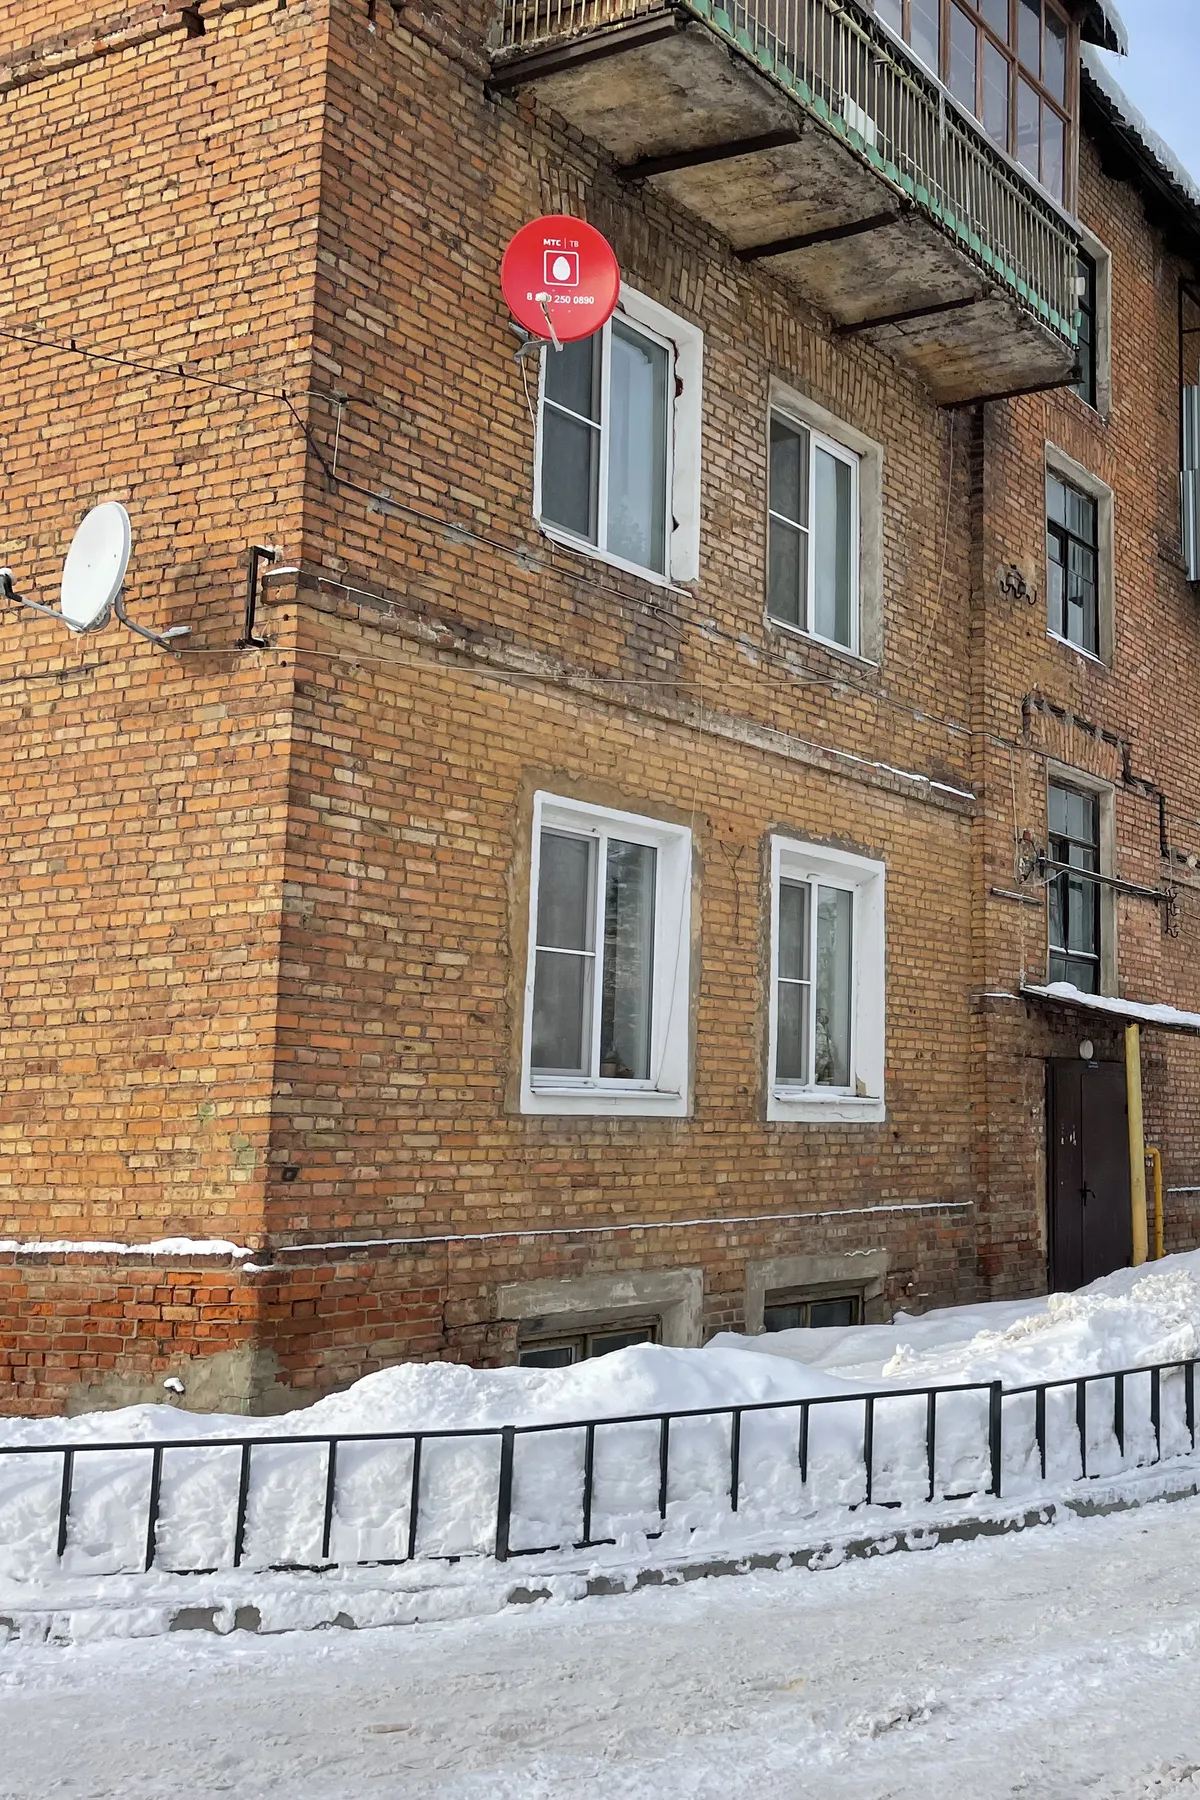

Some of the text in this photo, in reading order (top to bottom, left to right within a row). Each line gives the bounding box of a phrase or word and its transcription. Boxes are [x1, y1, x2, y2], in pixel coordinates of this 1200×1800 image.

[543, 238, 561, 246] МТС
[526, 292, 532, 300] 8
[554, 295, 571, 304] 250
[573, 296, 595, 304] 0890
